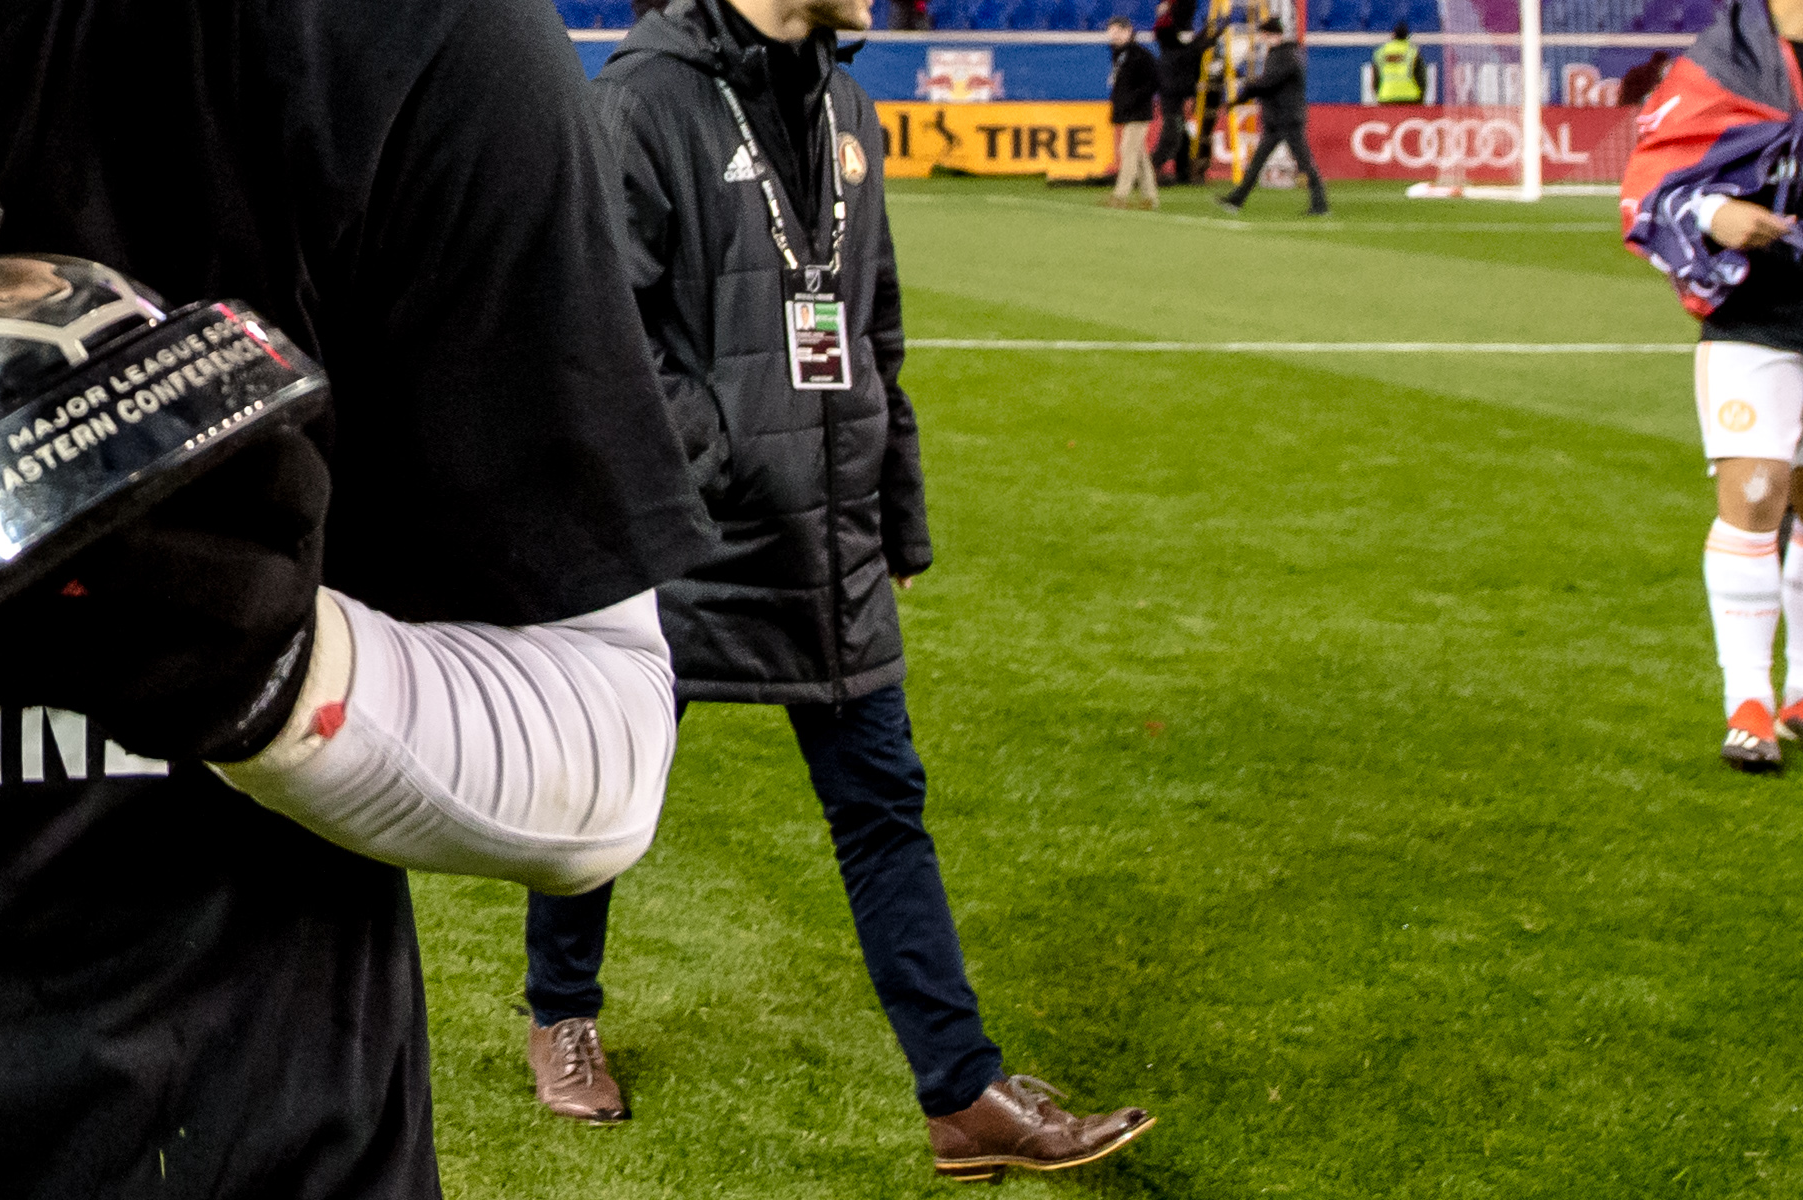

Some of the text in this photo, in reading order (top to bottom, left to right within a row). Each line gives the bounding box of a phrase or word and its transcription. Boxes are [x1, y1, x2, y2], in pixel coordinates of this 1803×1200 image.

[977, 123, 1096, 160] TIRE
[7, 384, 109, 452] MAJOR
[109, 331, 206, 394] LEAGUE
